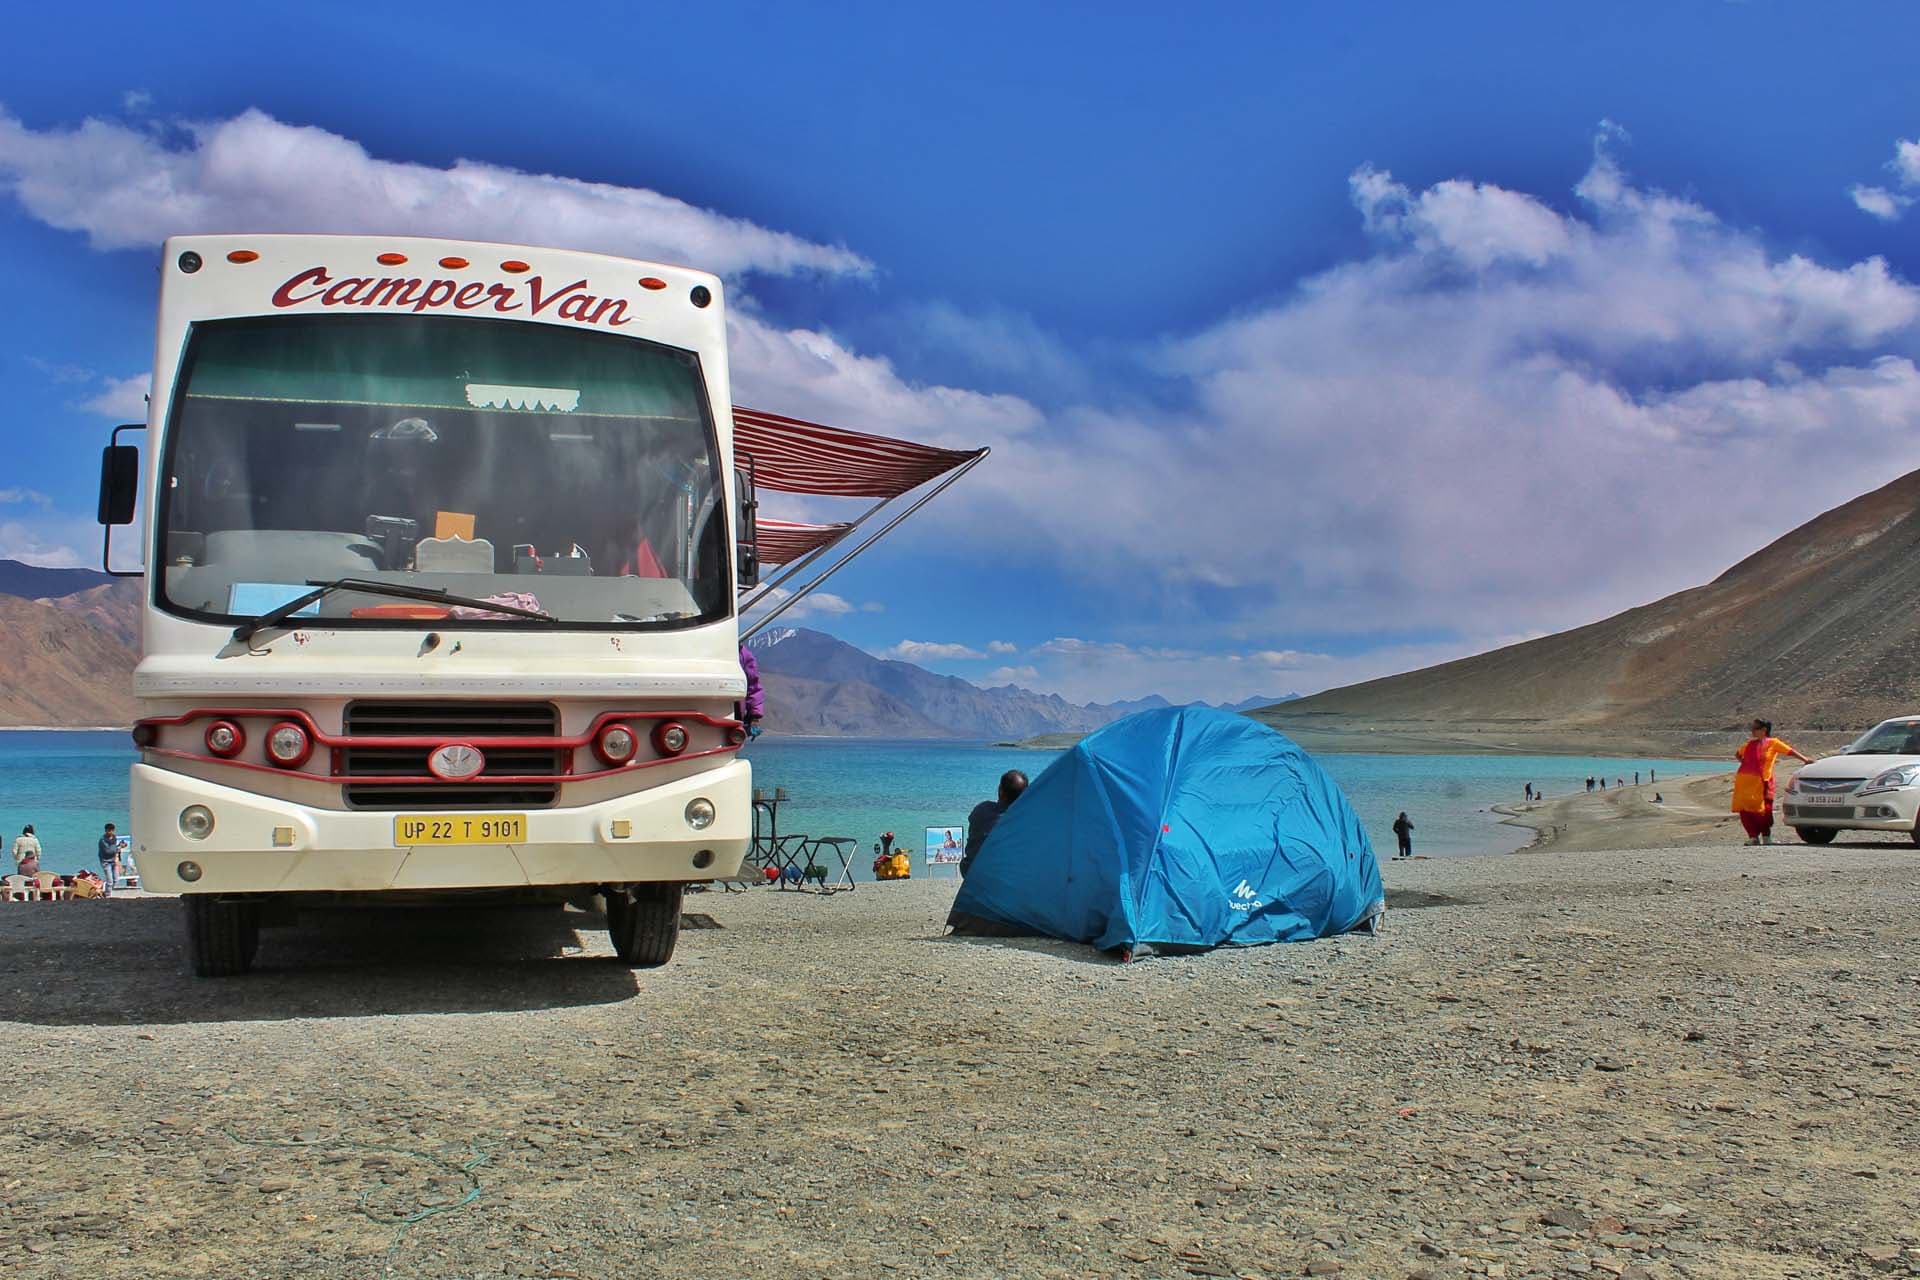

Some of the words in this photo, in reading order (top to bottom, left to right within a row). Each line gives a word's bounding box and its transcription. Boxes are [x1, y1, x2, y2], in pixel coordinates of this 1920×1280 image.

[404, 822, 426, 839] UP
[431, 822, 453, 839] 22
[463, 821, 473, 838] T
[481, 820, 520, 838] 9101
